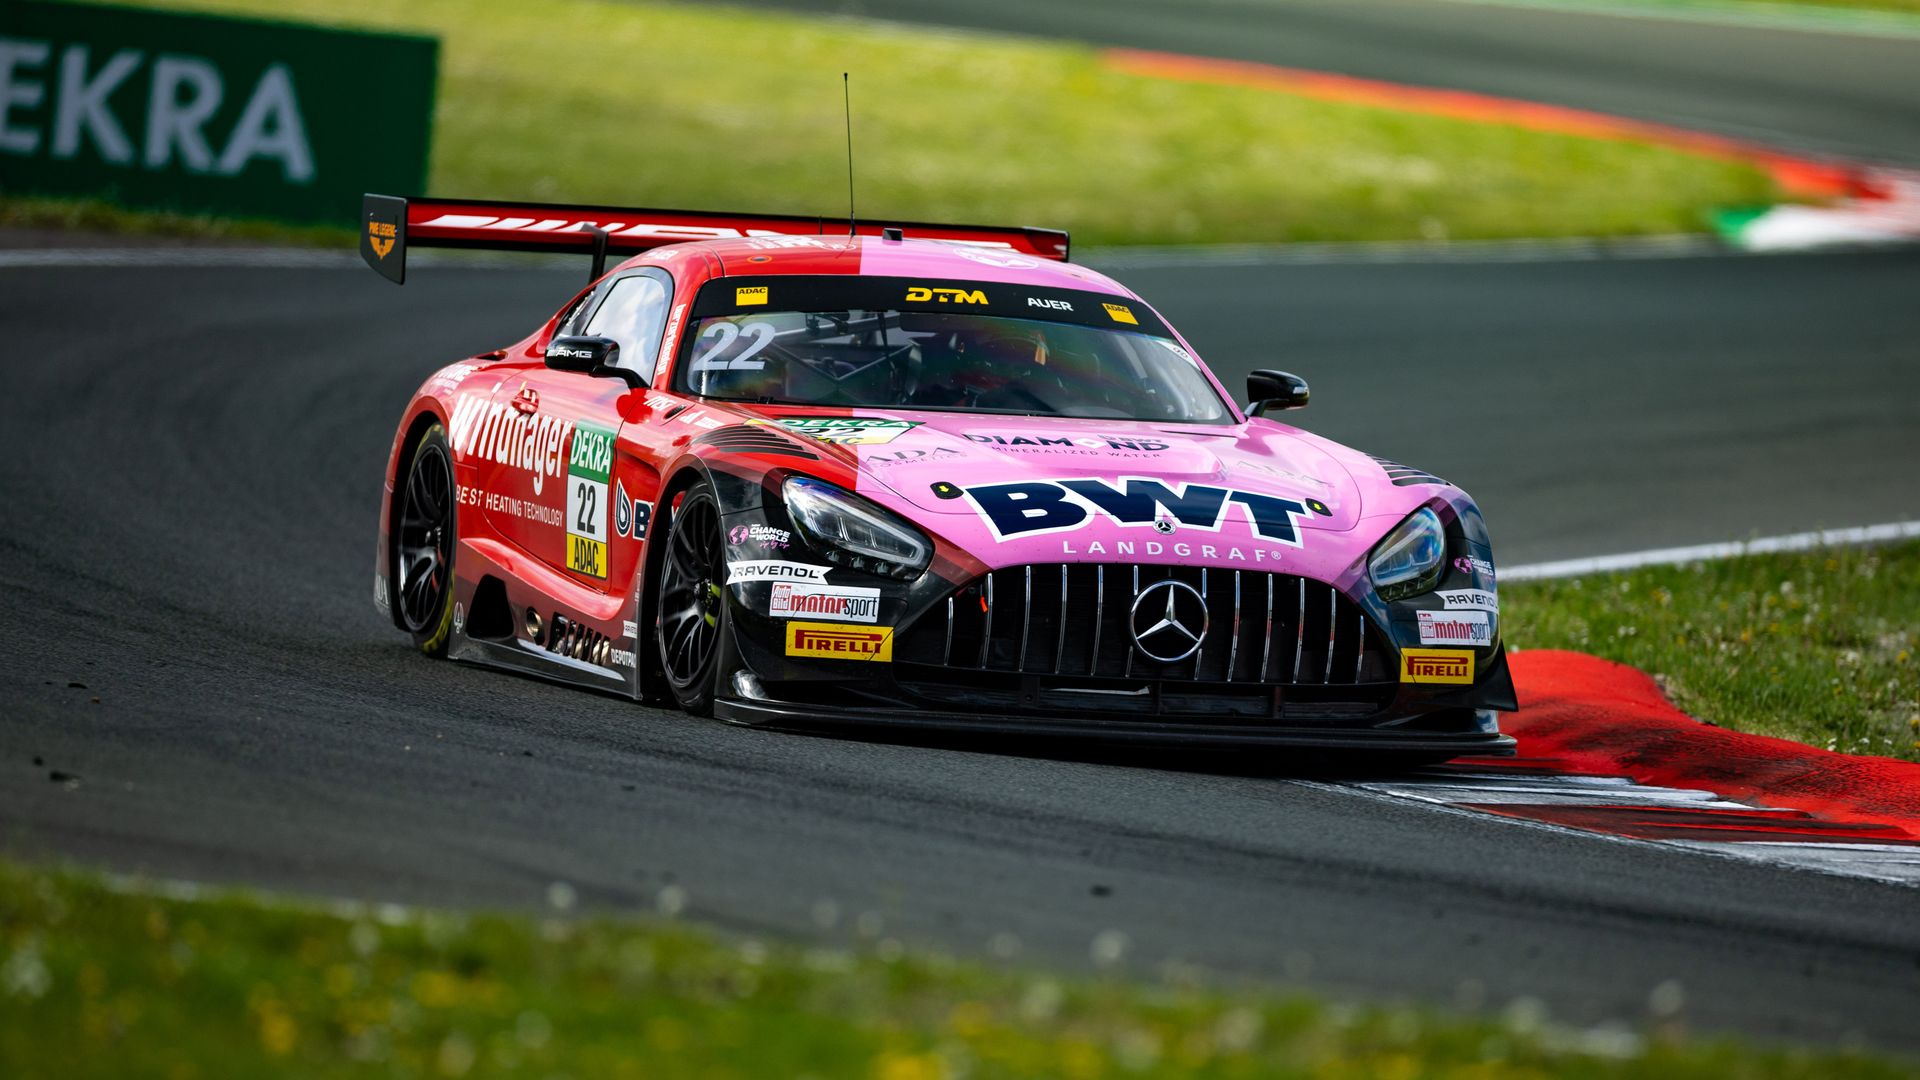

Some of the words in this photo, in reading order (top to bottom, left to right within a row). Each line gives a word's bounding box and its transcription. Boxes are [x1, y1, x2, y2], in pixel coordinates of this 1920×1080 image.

[738, 287, 766, 296] ADAC
[905, 287, 989, 304] DTM
[1027, 297, 1074, 312] AUER
[555, 350, 593, 359] AMG
[693, 321, 776, 371] 22
[778, 419, 911, 429] DEKRA
[571, 428, 611, 475] DEKRA
[990, 446, 1099, 457] MINERALIZED
[456, 483, 482, 507] BEST
[485, 491, 522, 519] HEATING
[523, 500, 564, 528] TECHNOLOGY
[576, 482, 597, 535] 22
[962, 475, 1311, 549] BWT
[750, 526, 790, 538] CHANGE
[755, 533, 788, 543] WORLD
[573, 537, 599, 576] ADAC
[795, 629, 884, 654] PIRELLI
[1407, 656, 1469, 677] PIRELLI
